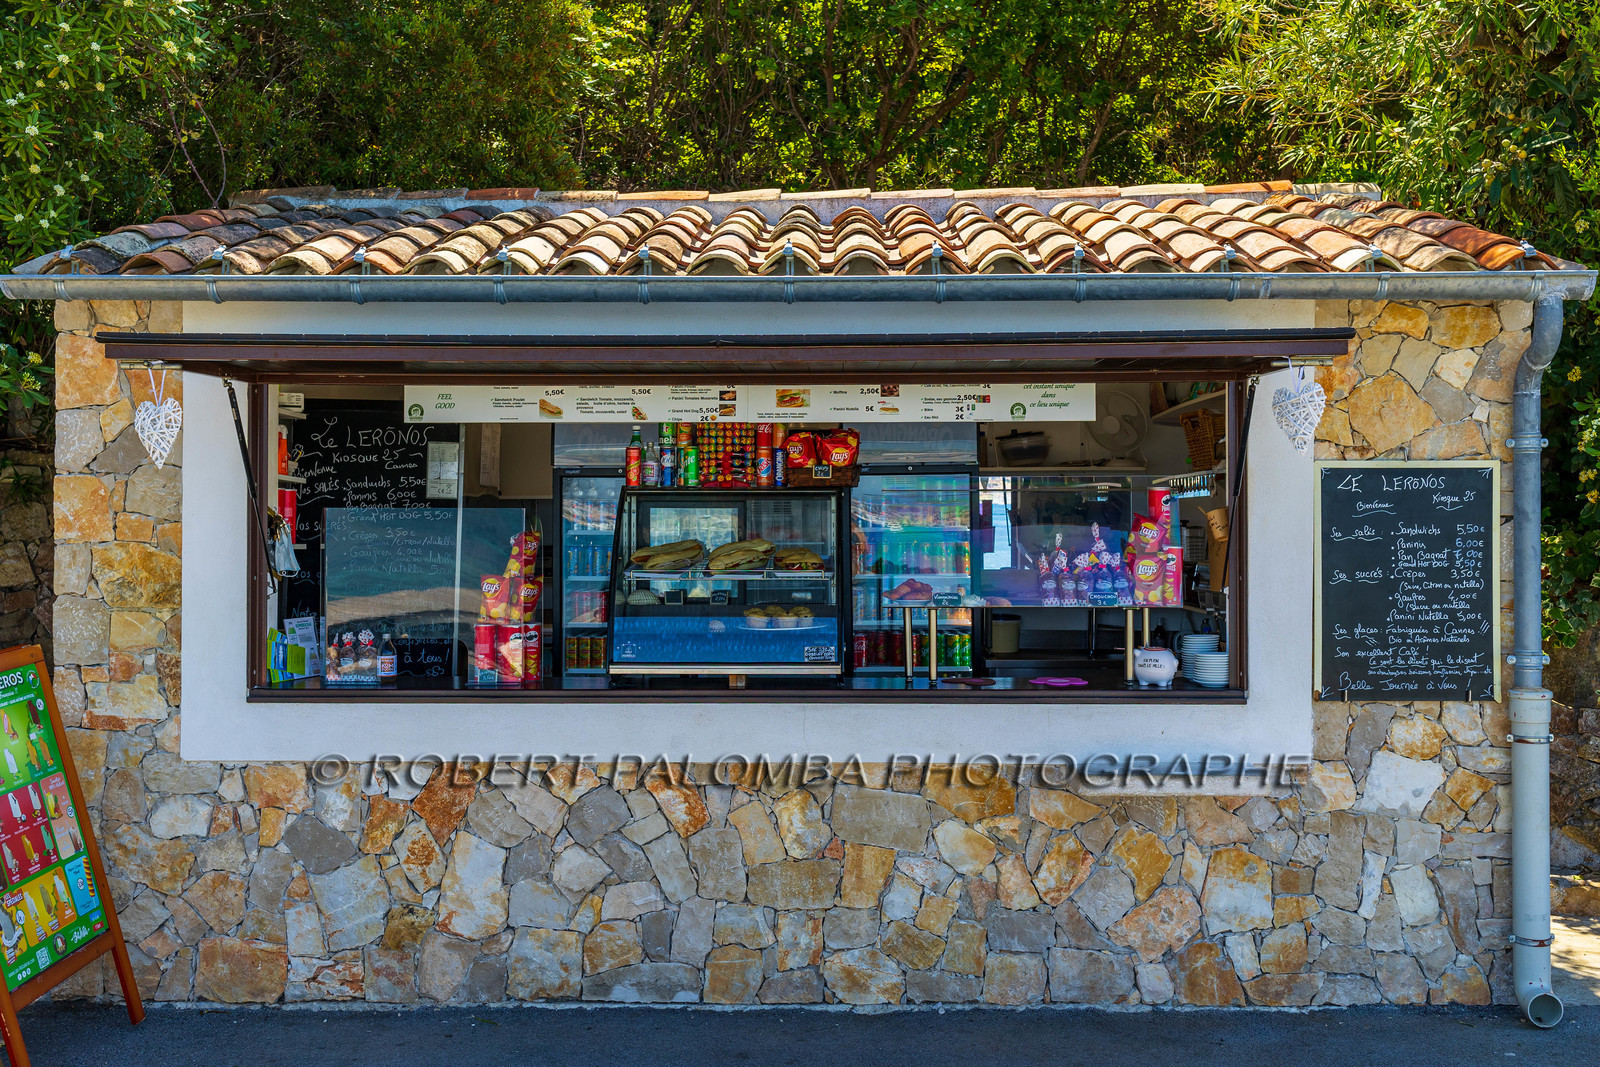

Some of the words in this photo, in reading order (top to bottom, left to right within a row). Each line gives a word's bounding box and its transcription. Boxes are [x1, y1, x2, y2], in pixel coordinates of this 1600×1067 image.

[545, 389, 565, 397] 5,50€
[1049, 401, 1070, 409] unique
[310, 416, 339, 448] Le
[332, 452, 379, 464] KIOSQUE
[381, 448, 406, 461] 25
[831, 451, 849, 463] Lay's
[400, 476, 427, 489] 5,50€
[1337, 474, 1363, 493] LE
[386, 488, 417, 501] 6,00€
[1432, 492, 1460, 508] Kiosque
[1463, 490, 1476, 501] 25
[1356, 500, 1394, 511] Bienvenue
[380, 511, 397, 521] HOT
[399, 511, 421, 520] DOG
[424, 511, 455, 521] 5,50€
[1140, 525, 1158, 539] Lay's
[1456, 524, 1485, 535] 5,50€
[1396, 537, 1427, 550] Paninis
[1455, 537, 1484, 548] 6,00€
[1397, 550, 1413, 563] Pan
[1417, 547, 1451, 561] Bagnat
[1137, 563, 1158, 576] Lay's
[1394, 567, 1427, 582] Crêpes
[1450, 569, 1480, 580] 3,50€
[482, 582, 500, 594] Lay's
[520, 587, 538, 598] Lay's
[1448, 590, 1477, 601] 4,00€
[1388, 609, 1415, 621] Panini
[1419, 610, 1449, 621] Nutella
[1456, 610, 1482, 622] 5,00€
[1433, 624, 1440, 634] à
[1444, 621, 1475, 635] Cannes
[1388, 635, 1402, 644] Bio
[416, 648, 442, 664] tous
[1334, 647, 1350, 658] Son
[1398, 646, 1420, 659] Café
[1381, 677, 1419, 691] Journée
[1426, 680, 1435, 690] à
[1437, 677, 1458, 690] Vous
